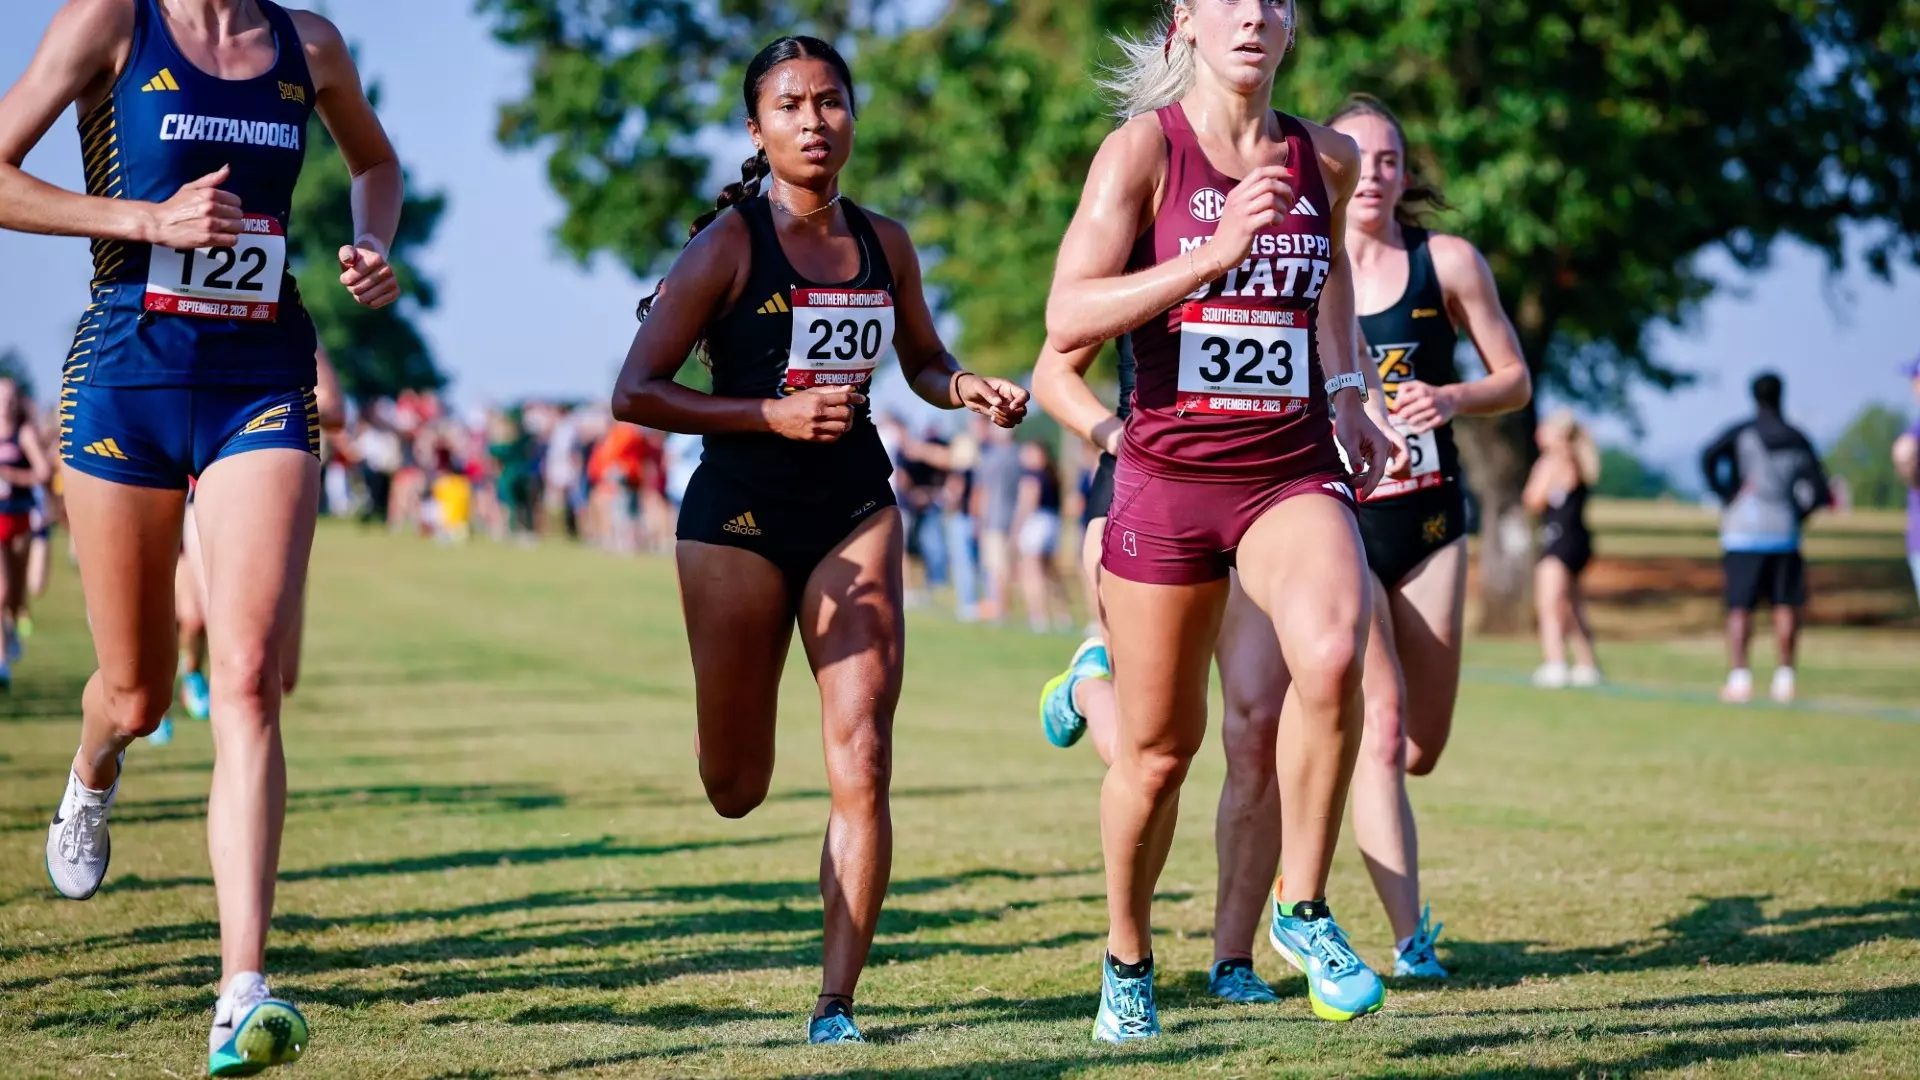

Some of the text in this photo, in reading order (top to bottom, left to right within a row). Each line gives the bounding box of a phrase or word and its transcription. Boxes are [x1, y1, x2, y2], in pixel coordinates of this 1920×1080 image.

[160, 113, 300, 150] CHATTANOOGA
[1192, 190, 1226, 221] SEC
[1179, 233, 1330, 259] MISSIPPI
[174, 246, 268, 292] 122
[1183, 257, 1330, 300] TATE
[177, 300, 219, 315] SEPTEMBER
[229, 305, 248, 317] 2025
[808, 293, 885, 306] SOUTHERN SHOWCASE
[1202, 307, 1295, 326] SOUTHERN SHOWCASE
[806, 318, 882, 361] 230
[1198, 336, 1294, 386] 323
[814, 373, 848, 385] SEPTEMBER
[1209, 397, 1252, 411] SEPTEMBER
[1262, 399, 1281, 413] 2025
[722, 523, 762, 536] adidas
